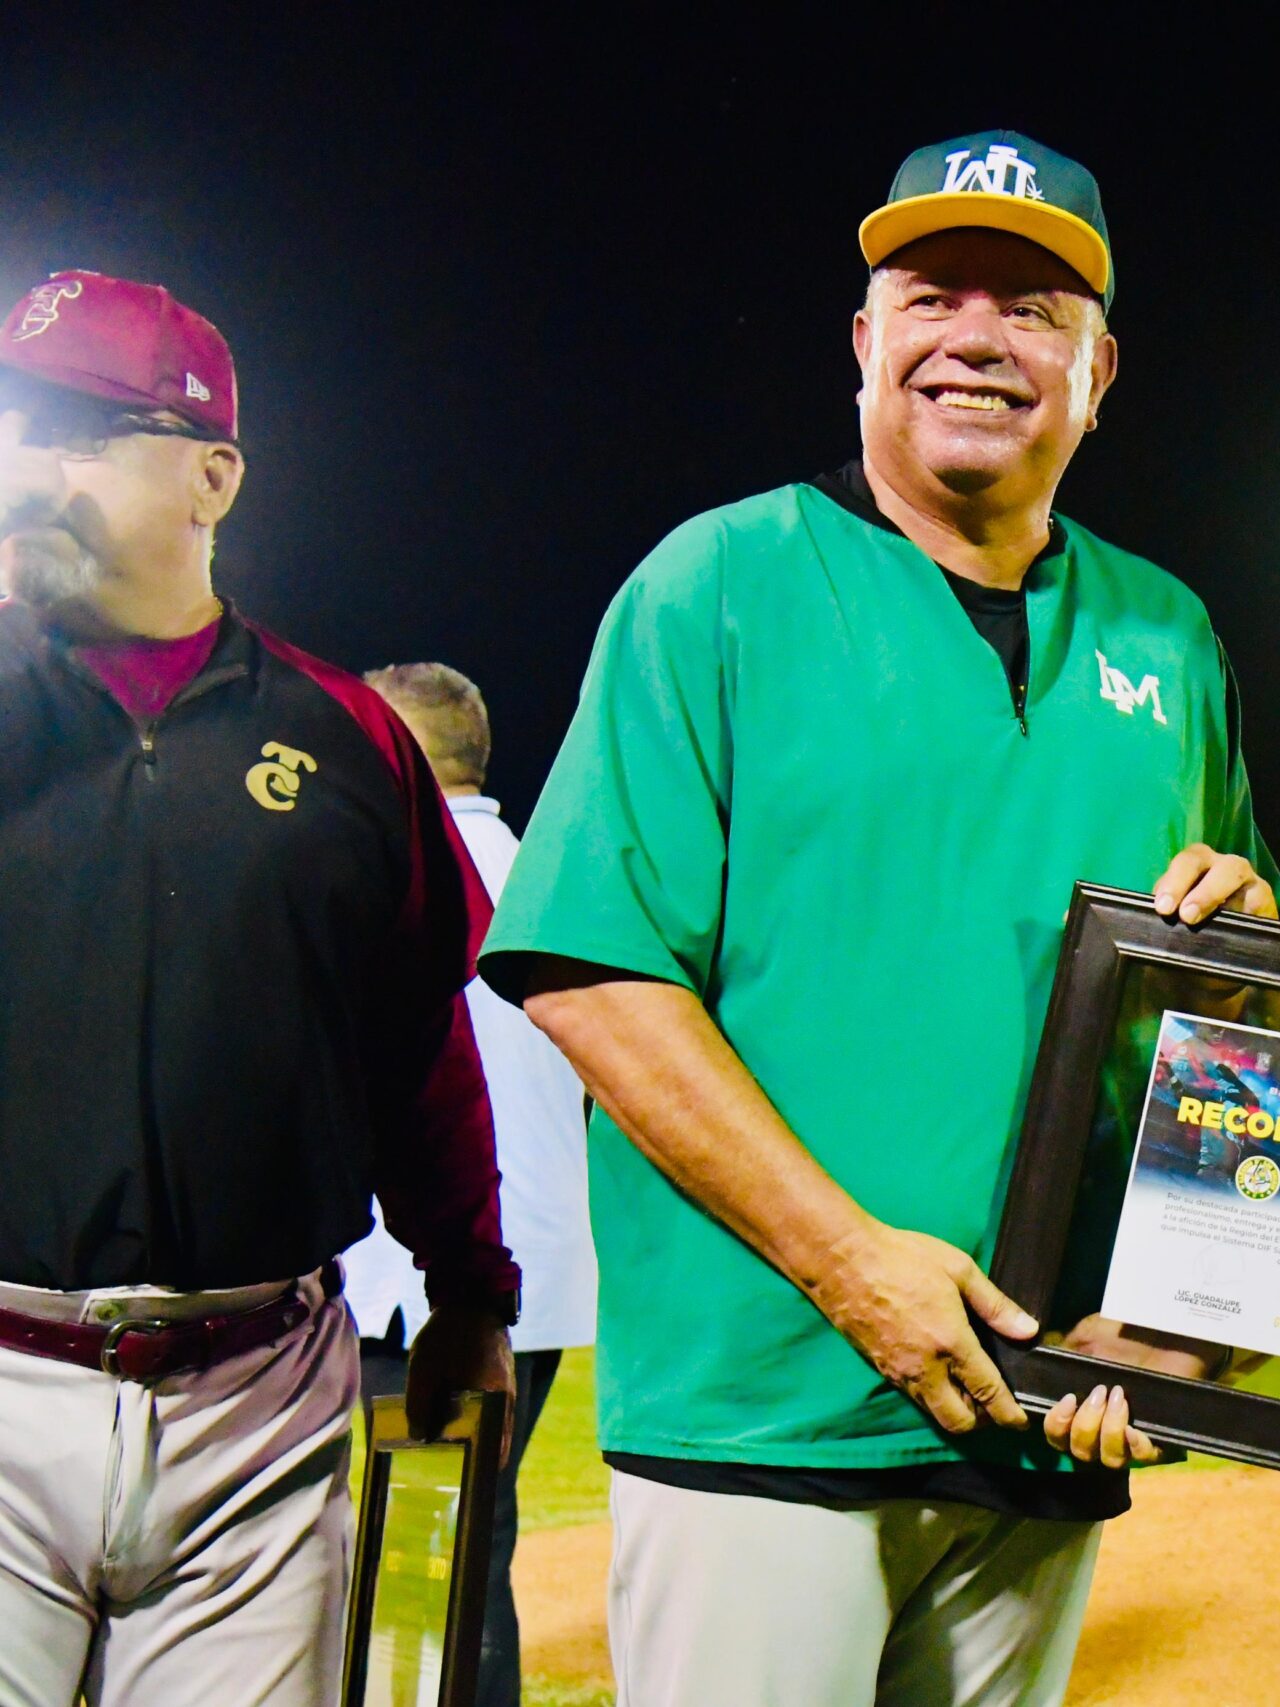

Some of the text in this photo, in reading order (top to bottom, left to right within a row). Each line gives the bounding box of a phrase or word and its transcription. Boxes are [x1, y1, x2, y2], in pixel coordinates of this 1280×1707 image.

[1095, 648, 1167, 725] LM
[1178, 1289, 1241, 1308] LIC. GUADALUPE
